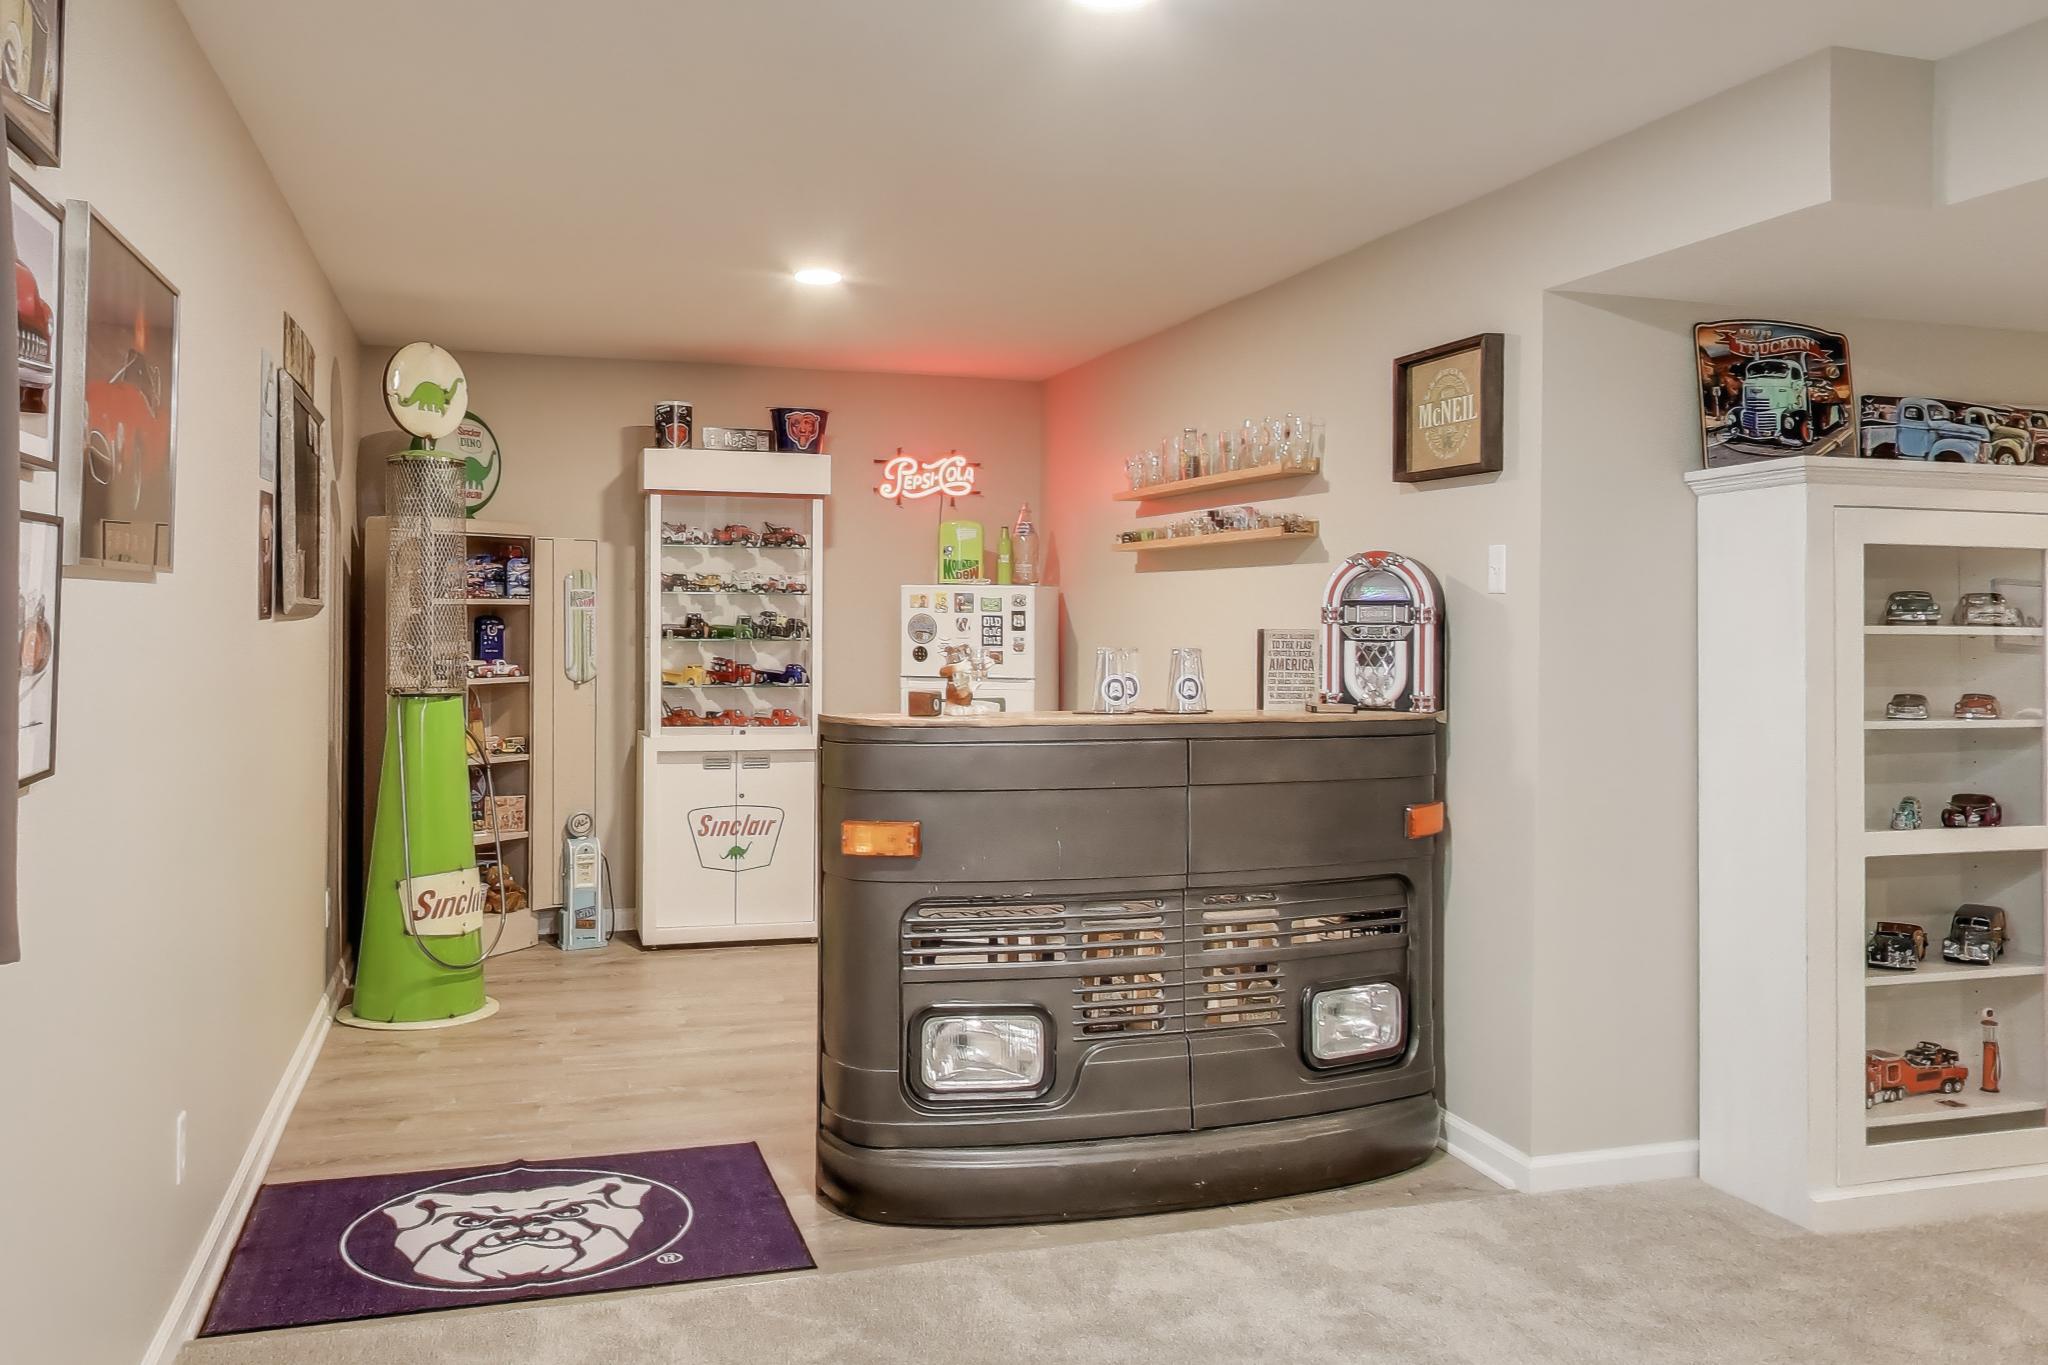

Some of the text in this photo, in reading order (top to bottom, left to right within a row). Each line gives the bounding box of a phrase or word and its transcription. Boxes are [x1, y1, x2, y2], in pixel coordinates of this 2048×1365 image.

[1418, 393, 1477, 429] McNEIL
[460, 437, 482, 448] DINO
[1269, 658, 1314, 671] AMERICA
[697, 813, 777, 837] Sinclair
